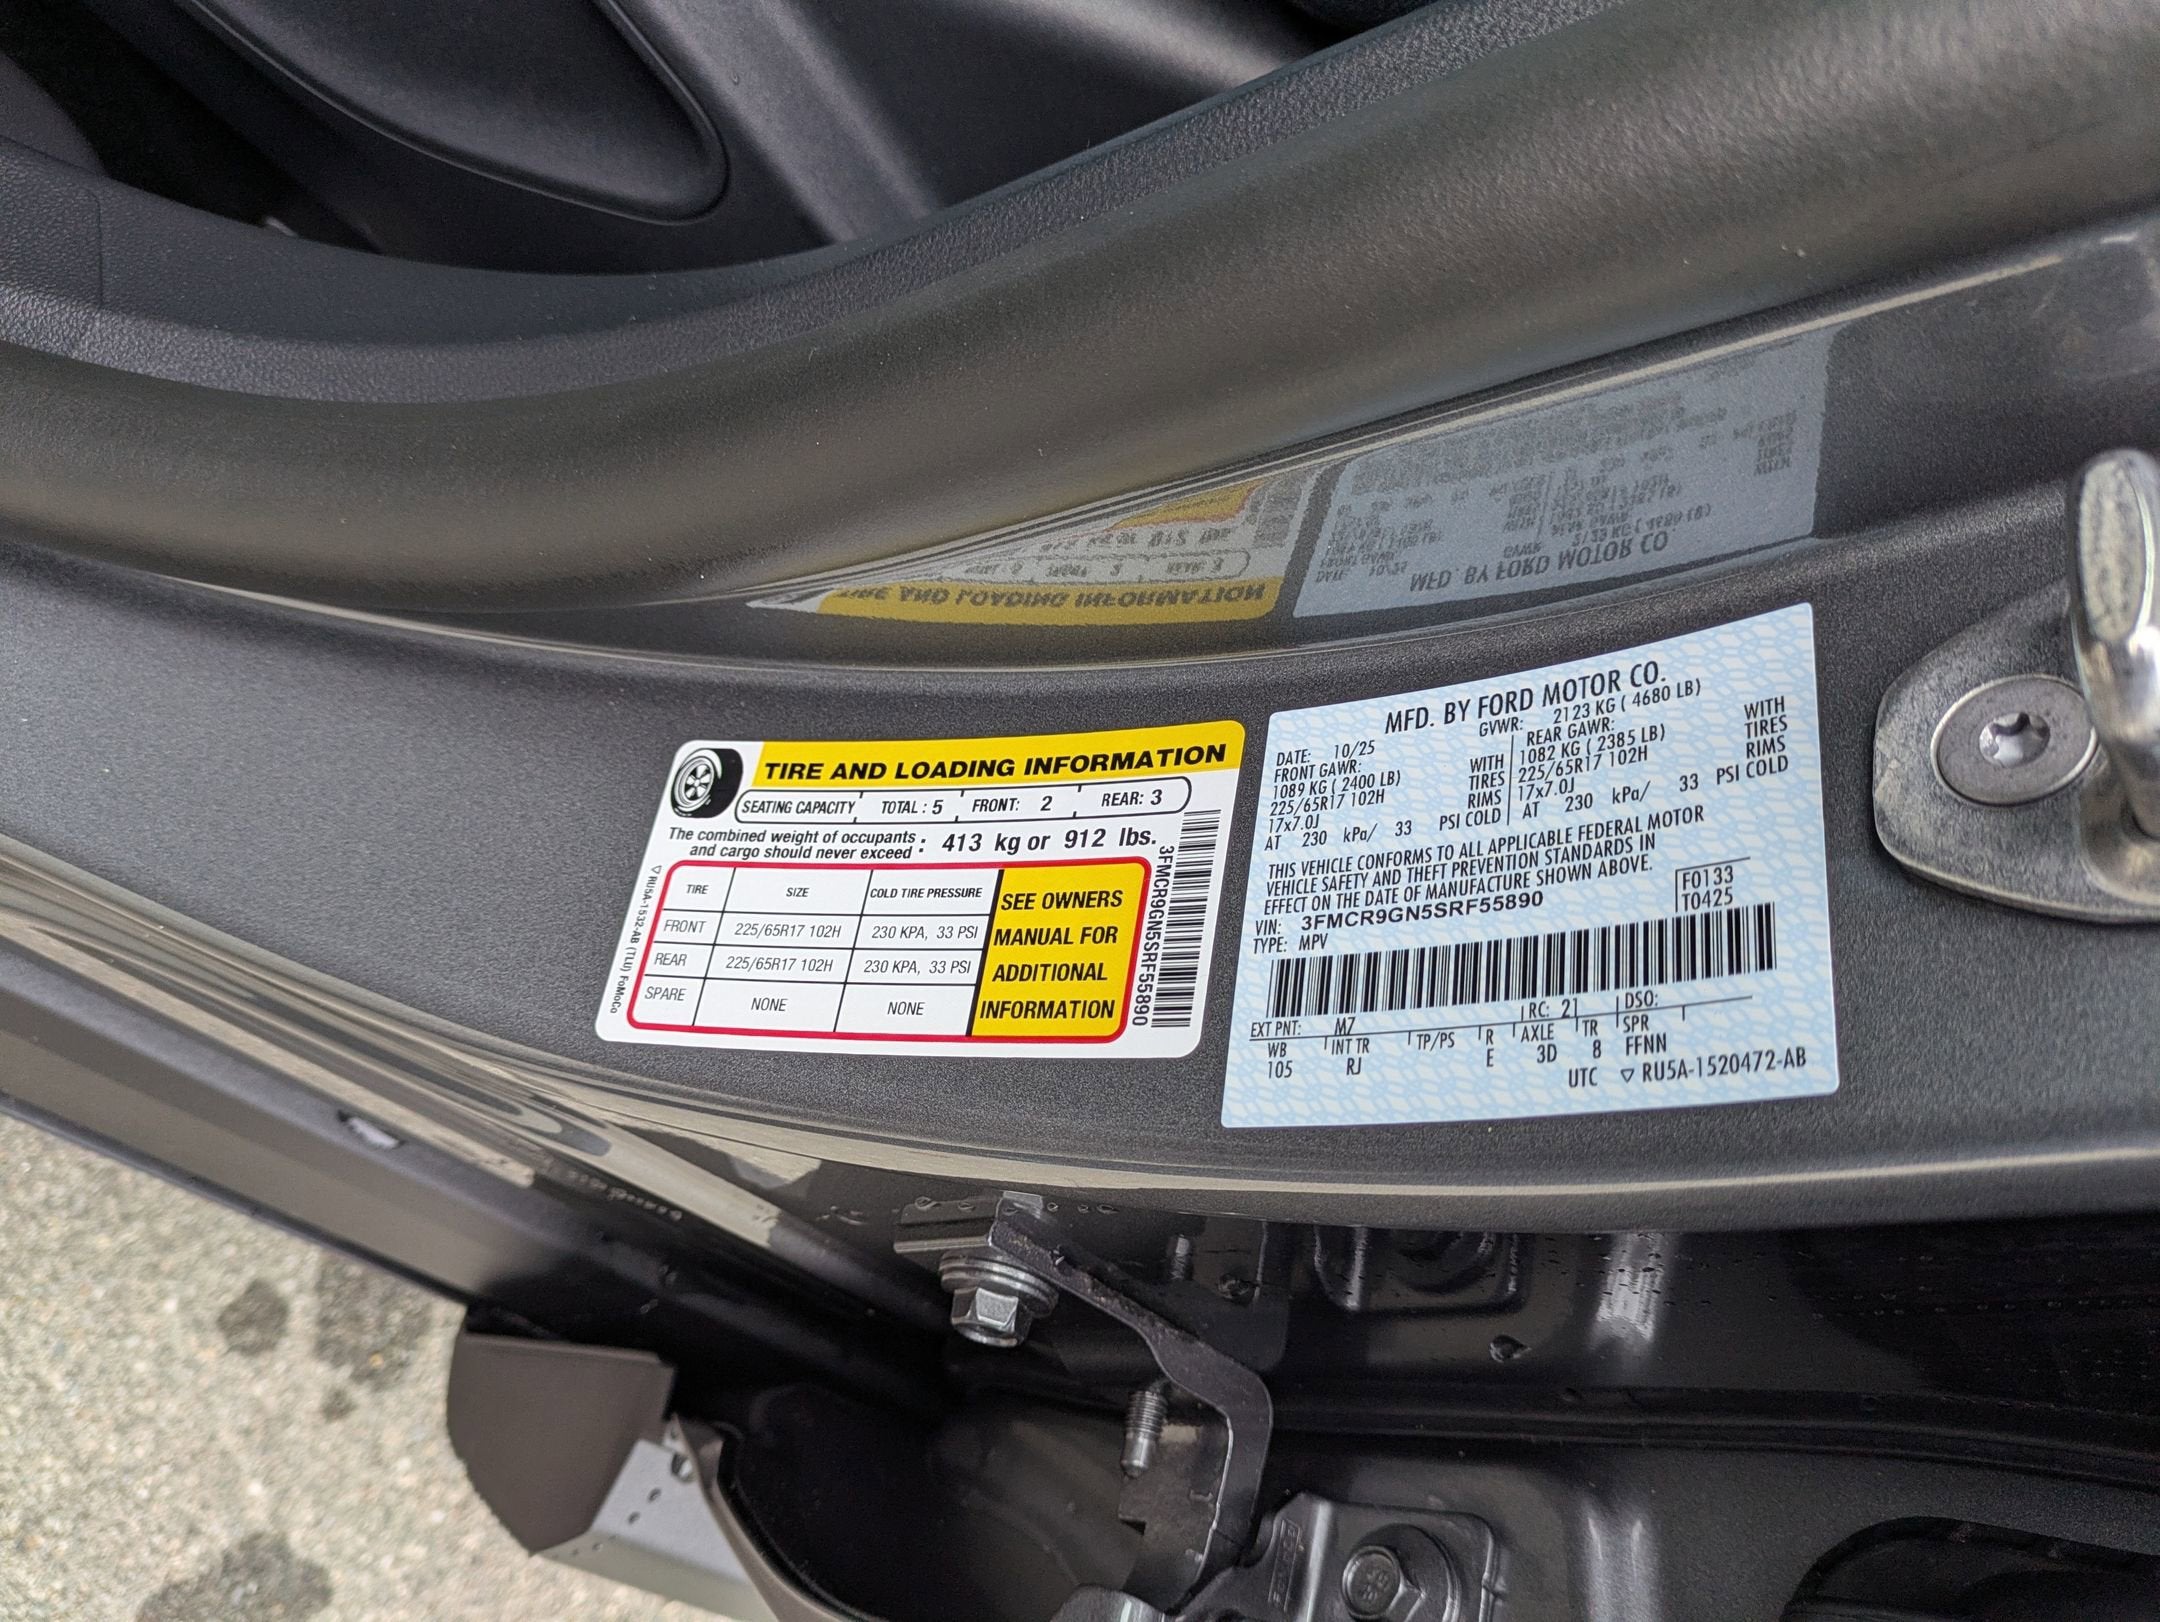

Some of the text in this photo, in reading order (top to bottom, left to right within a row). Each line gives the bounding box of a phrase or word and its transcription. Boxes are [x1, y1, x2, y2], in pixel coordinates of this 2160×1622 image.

[1385, 661, 1666, 734] MFD. BY FORD MOTOR CO.
[1479, 678, 1701, 737] GVWR: 2123 KG 4680 LB)
[1744, 696, 1785, 720] WITH
[1526, 717, 1615, 746] REAR GAWR:
[1744, 714, 1788, 739] TIRES
[1276, 740, 1375, 766] DATE: 10/25
[1520, 723, 1666, 765] 1082 KG 2385 LB)
[1746, 736, 1786, 759] RIMS
[765, 744, 1226, 780] TIRE AND LOADING INFORMATION
[1274, 759, 1362, 783] FRONT GAWR:
[1470, 754, 1504, 773] WITH
[1518, 745, 1648, 783] 225/65R17 102H
[1716, 755, 1789, 785] PSI COLD
[1273, 770, 1401, 800] 1089 KG 2400 LB)
[1469, 771, 1505, 791] TIRES
[932, 799, 944, 814] 5
[972, 796, 1052, 812] FRONT: 2
[1101, 789, 1162, 807] REAR: 3
[1270, 789, 1385, 817] 225/65R17 102H
[1468, 793, 1502, 809] RIMS
[1522, 773, 1699, 820] AT 230 33
[742, 800, 855, 814] SEATING CAPACITY
[1439, 808, 1502, 831] PSI COLD
[669, 827, 1156, 855] The combined weight of occupants 413 kg or 912 lbs.
[1264, 820, 1412, 851] AT 230 33
[1269, 804, 1705, 879] THIS VEHICLE CONFORMS TO ALL APPLICABLE FEDERAL MOTOR
[690, 844, 912, 860] and cargo should never exceed
[1266, 832, 1656, 897] VEHICLE SAFETY AND THEFT PREVENTION STANDARDS IN
[686, 884, 709, 894] TIRE
[786, 887, 810, 897] SIZE
[870, 888, 983, 898] COLD TIRE PRESSURE
[1264, 854, 1653, 915] EFFECT ON THE DATE OF MANUFACTURE SHOWN ABOVE.
[1000, 890, 1123, 910] SEE OWNERS
[1255, 890, 1543, 935] VIN: 3FMCR9GN5SRF55890
[663, 920, 707, 934] FRONT
[734, 923, 842, 938] 225/65R17 102H
[872, 926, 978, 941] 230 KPA, 33 PSI
[993, 926, 1118, 946] MANUAL FOR
[1132, 846, 1175, 1026] 3FMCR9GN5SRF55890
[1253, 933, 1328, 954] TYPE: MPV
[620, 947, 637, 971] (TLU)
[654, 953, 688, 967] REAR
[725, 956, 833, 972] 225/65R17 102H
[864, 960, 971, 975] 230 KPA, 33 PSI
[992, 962, 1108, 982] ADDITIONAL
[610, 976, 629, 1013] FoMoCo
[644, 986, 687, 1001] SPARE
[751, 998, 788, 1012] NONE
[887, 1001, 926, 1016] NONE
[980, 1000, 1115, 1019] INFORMATION
[1528, 1001, 1550, 1019] RC:
[1251, 1021, 1272, 1038] EXT
[1275, 1020, 1301, 1036] PNT:
[1521, 1023, 1554, 1042] AXLE
[1582, 1019, 1598, 1036] TR
[1623, 1014, 1649, 1033] SPR
[1268, 1042, 1287, 1058] WB
[1331, 1038, 1370, 1056] INT TR
[1416, 1032, 1455, 1051] TP/PS
[1625, 1033, 1667, 1056] FFNN
[1536, 1044, 1557, 1064] 3D
[1268, 1060, 1293, 1078] 105
[1346, 1057, 1362, 1076] RJ
[1568, 1046, 1807, 1089] UTC RU5A-1520472-AB
